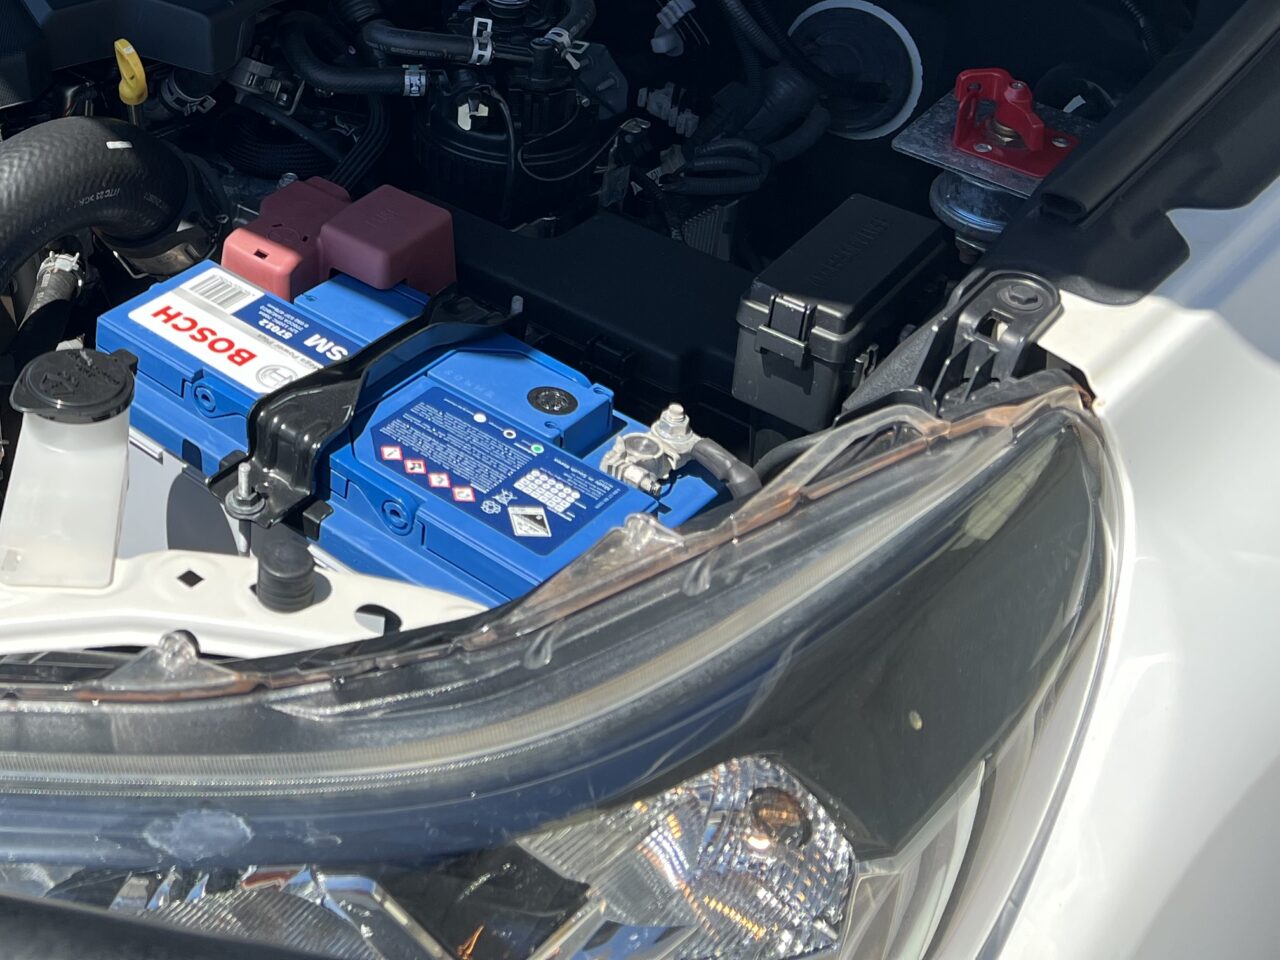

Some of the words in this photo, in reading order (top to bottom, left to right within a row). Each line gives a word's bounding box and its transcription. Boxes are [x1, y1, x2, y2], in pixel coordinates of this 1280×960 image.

[151, 305, 257, 367] BOSCH
[257, 318, 293, 340] 57012
[303, 333, 349, 361] SM
